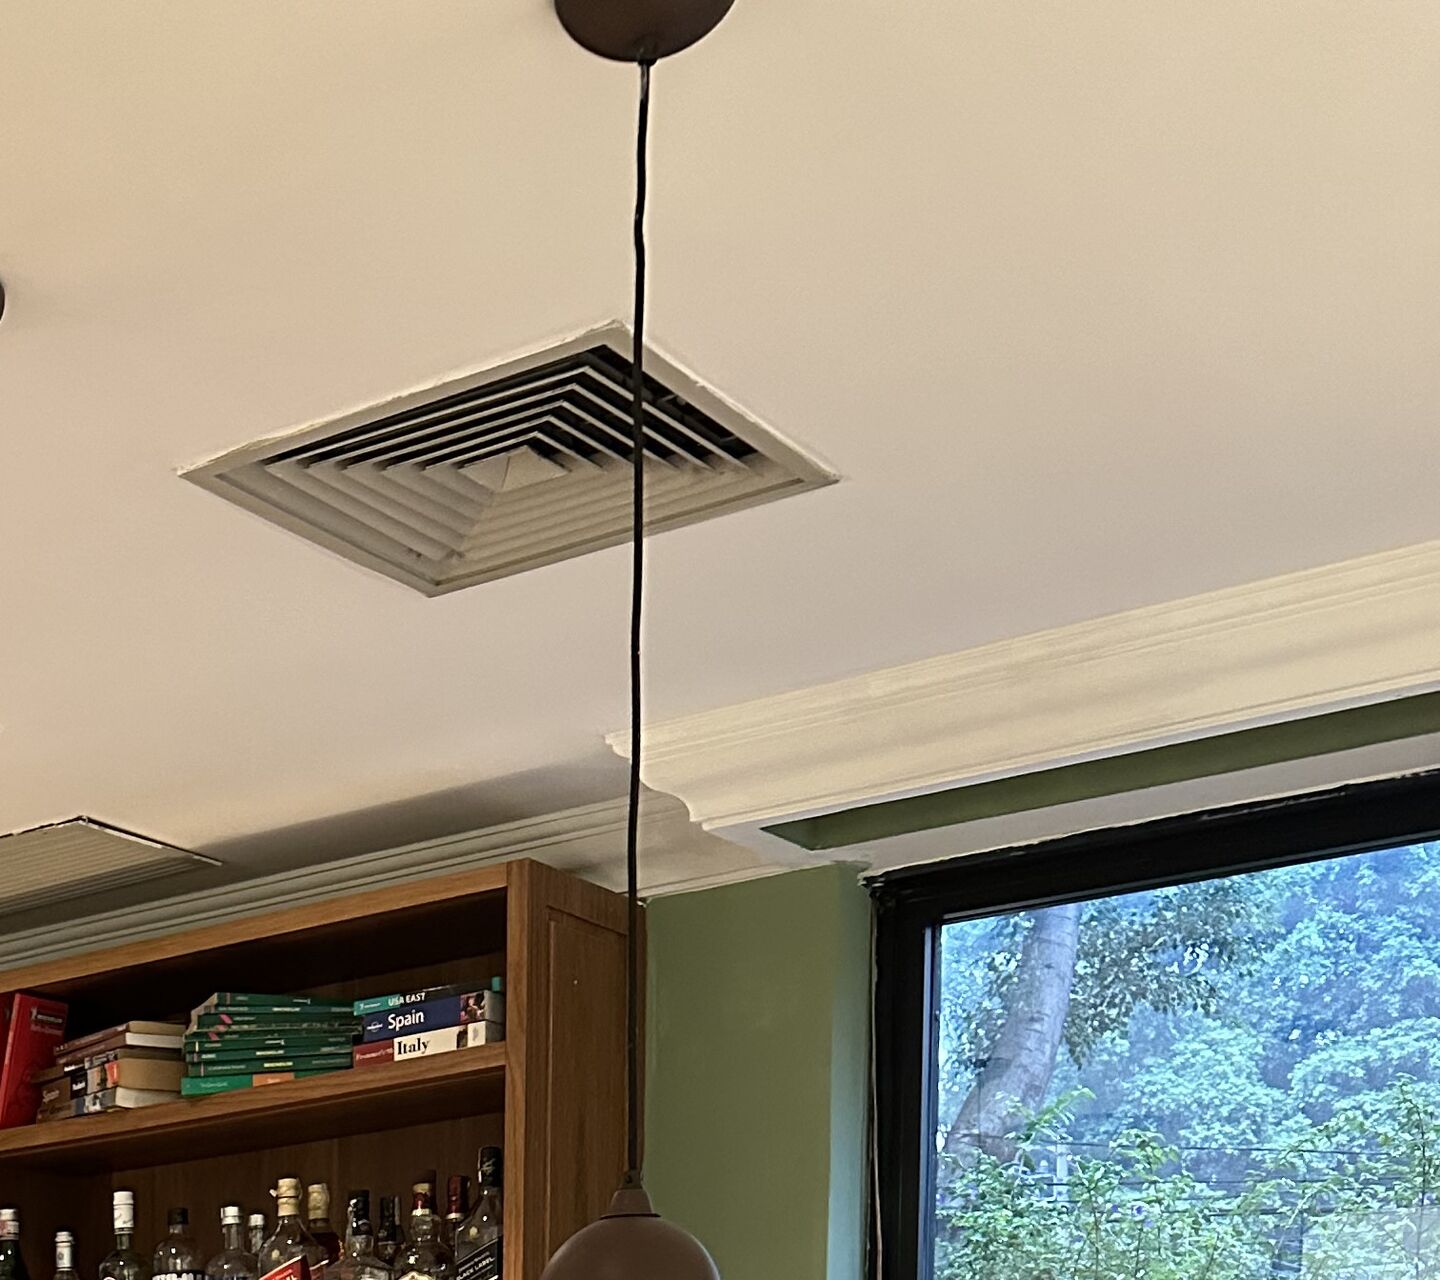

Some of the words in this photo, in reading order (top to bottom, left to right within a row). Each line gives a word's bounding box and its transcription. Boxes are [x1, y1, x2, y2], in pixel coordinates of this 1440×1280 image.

[387, 996, 405, 1007] USA
[405, 992, 426, 1003] EAST
[387, 1009, 425, 1032] Spain
[396, 1037, 430, 1055] Italy
